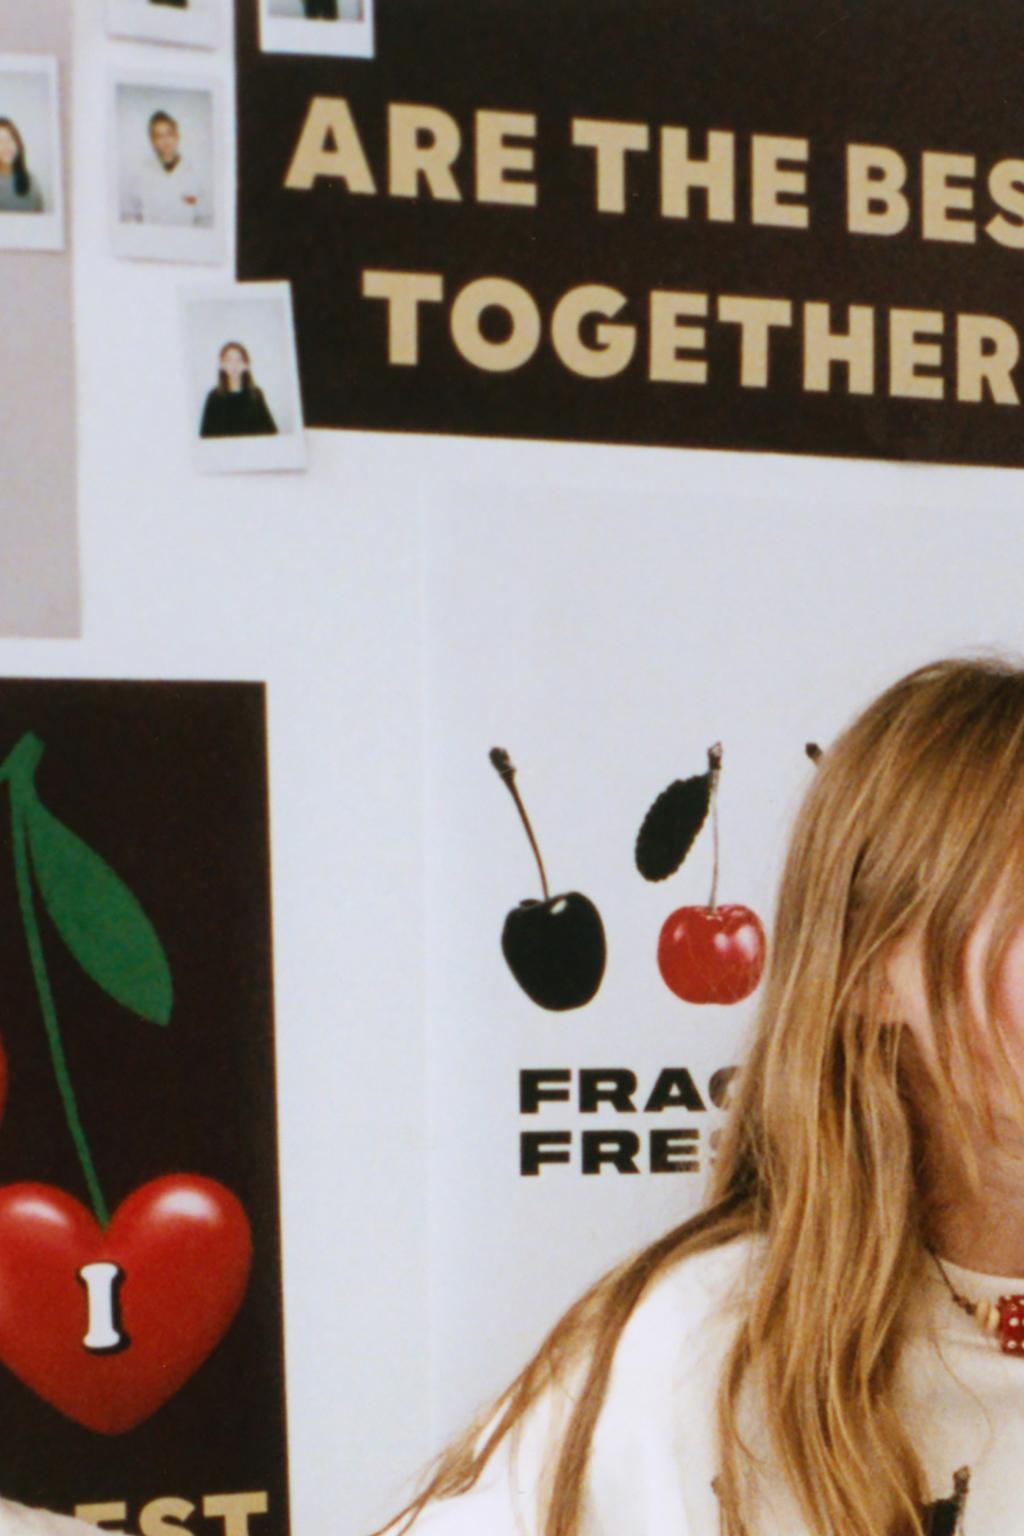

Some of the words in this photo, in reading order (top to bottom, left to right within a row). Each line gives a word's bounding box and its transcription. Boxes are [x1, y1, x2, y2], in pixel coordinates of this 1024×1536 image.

[283, 96, 539, 207] ARE
[571, 117, 810, 230] THE
[519, 1128, 719, 1177] FRE
[78, 1262, 125, 1351] I
